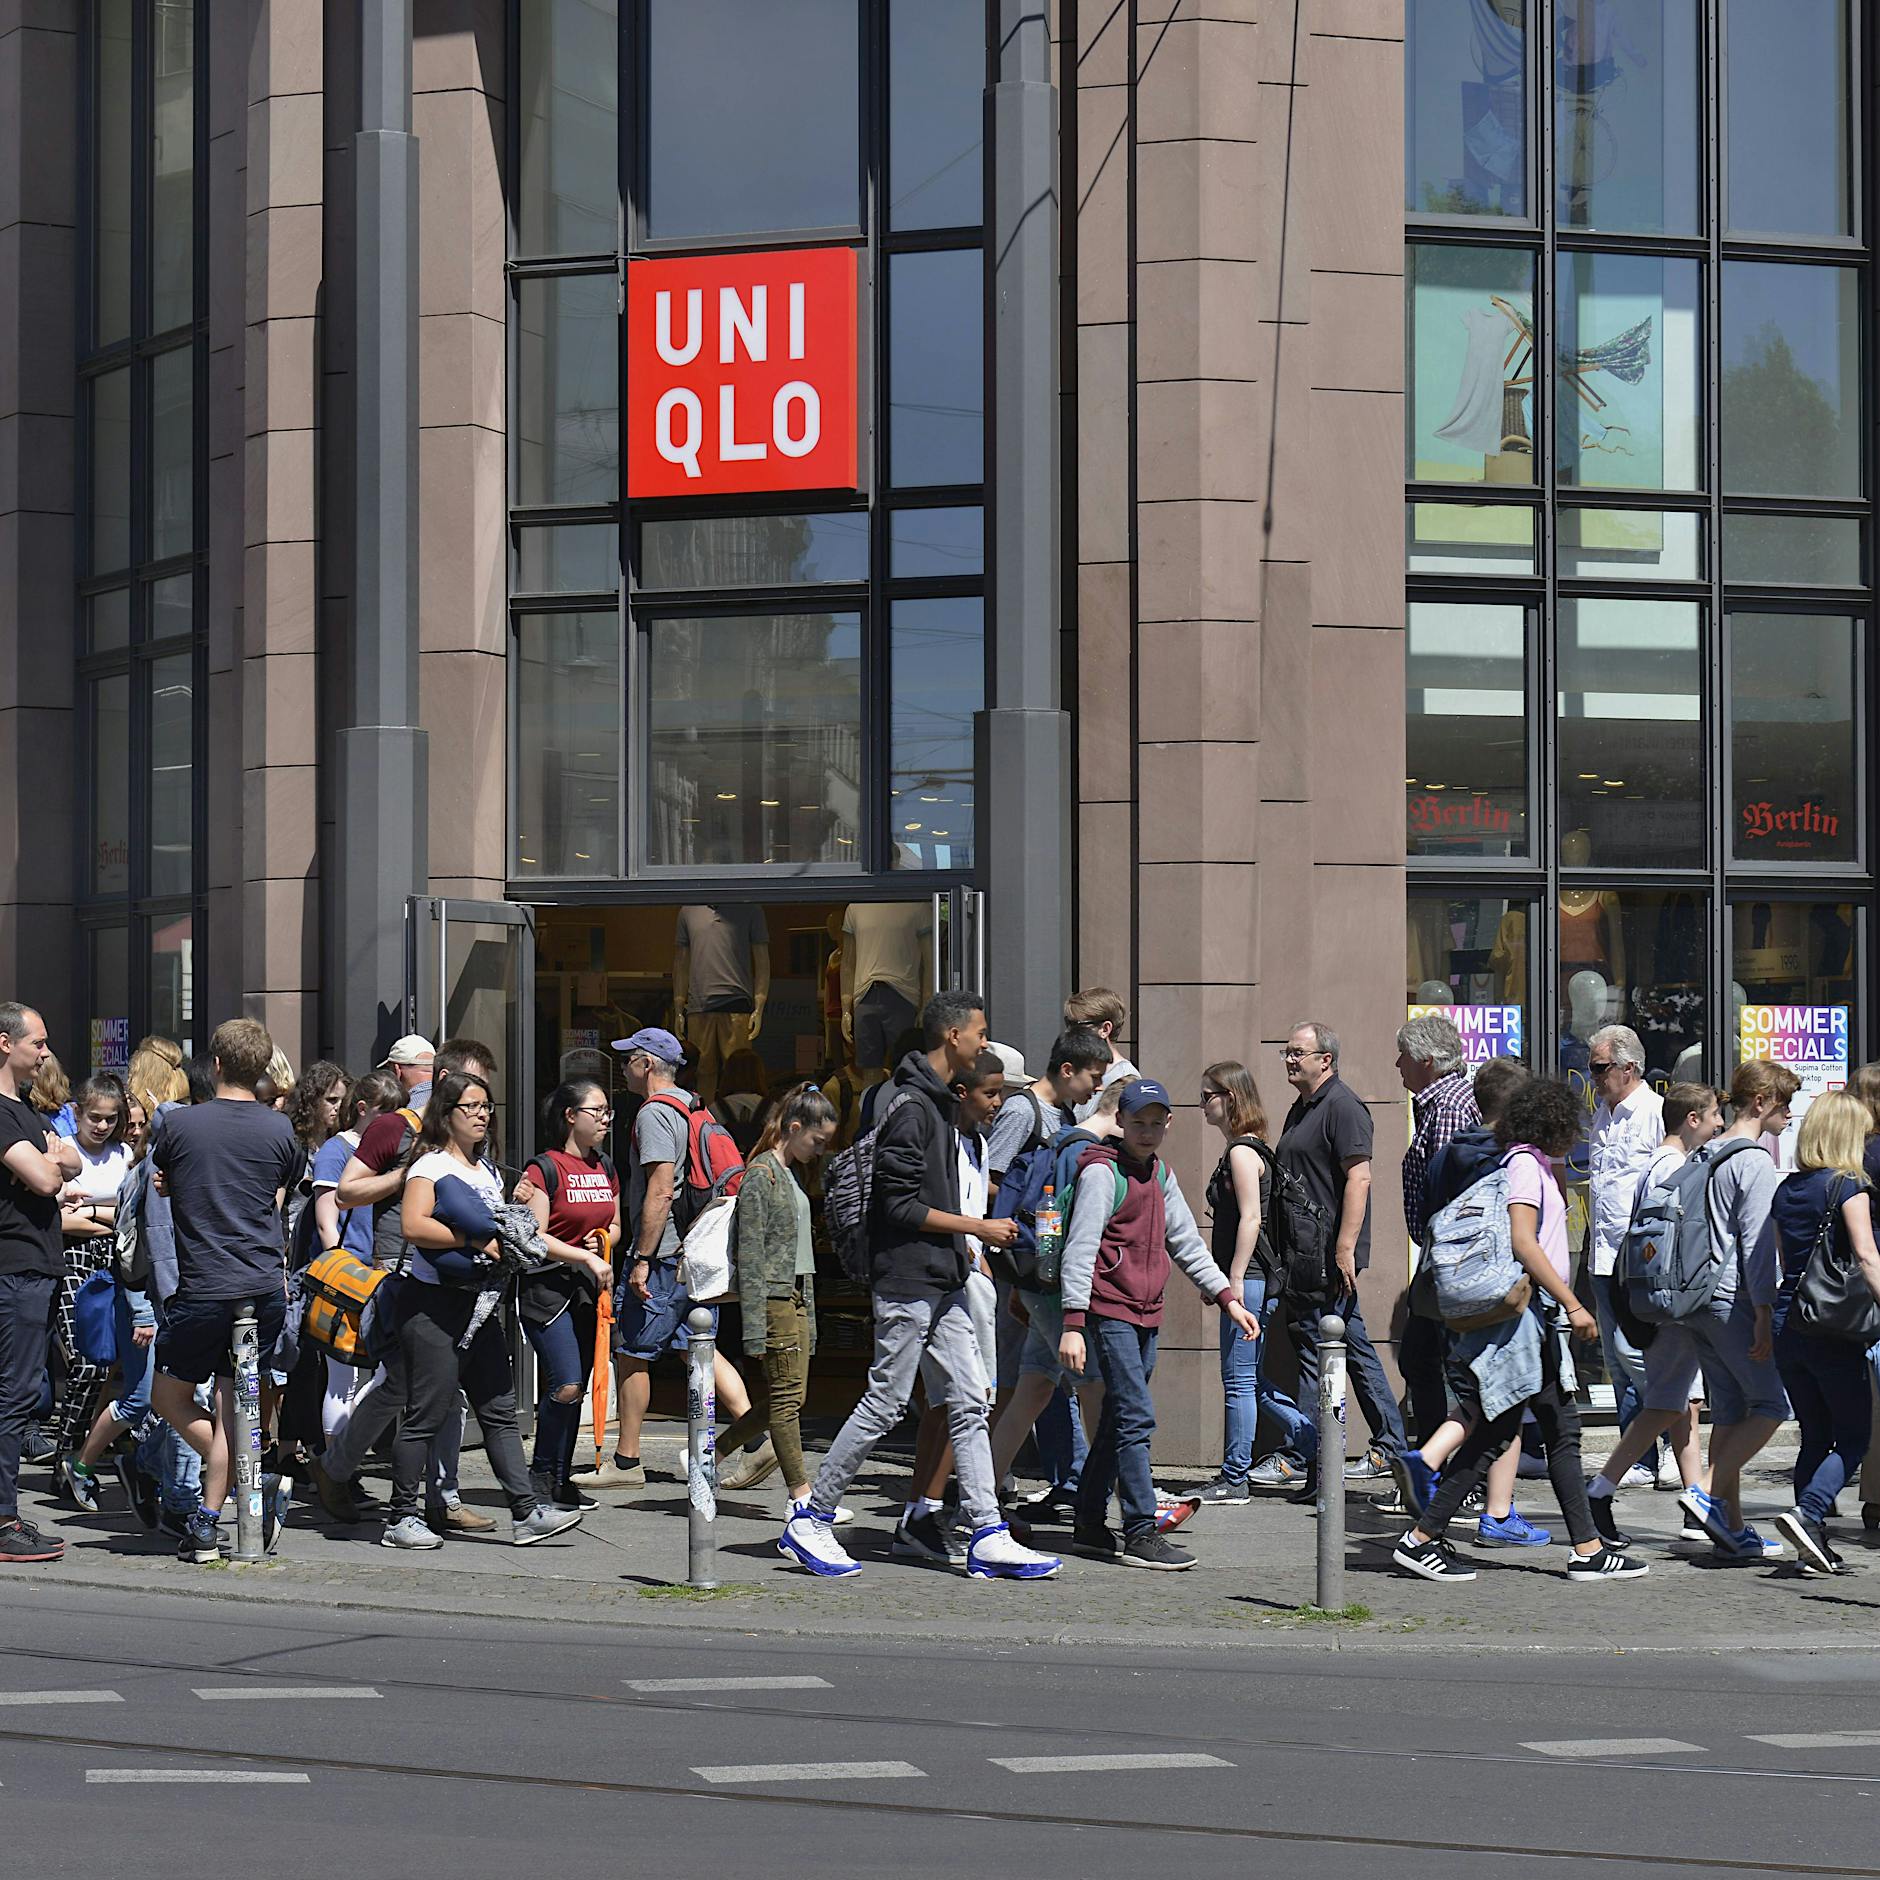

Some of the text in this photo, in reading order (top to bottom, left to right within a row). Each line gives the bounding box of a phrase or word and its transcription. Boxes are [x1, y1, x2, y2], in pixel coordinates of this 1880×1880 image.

[656, 282, 805, 367] UNI
[656, 380, 821, 478] QLO
[1409, 796, 1511, 832] Berlin
[1743, 802, 1839, 839] Berlin
[98, 839, 128, 870] Berli
[1742, 1008, 1847, 1034] SOMMER
[1461, 1038, 1520, 1060] CIALS
[1743, 1037, 1847, 1060] SPECIALS
[1794, 1064, 1844, 1073] Supima Cotton
[567, 1174, 610, 1188] STANFORD
